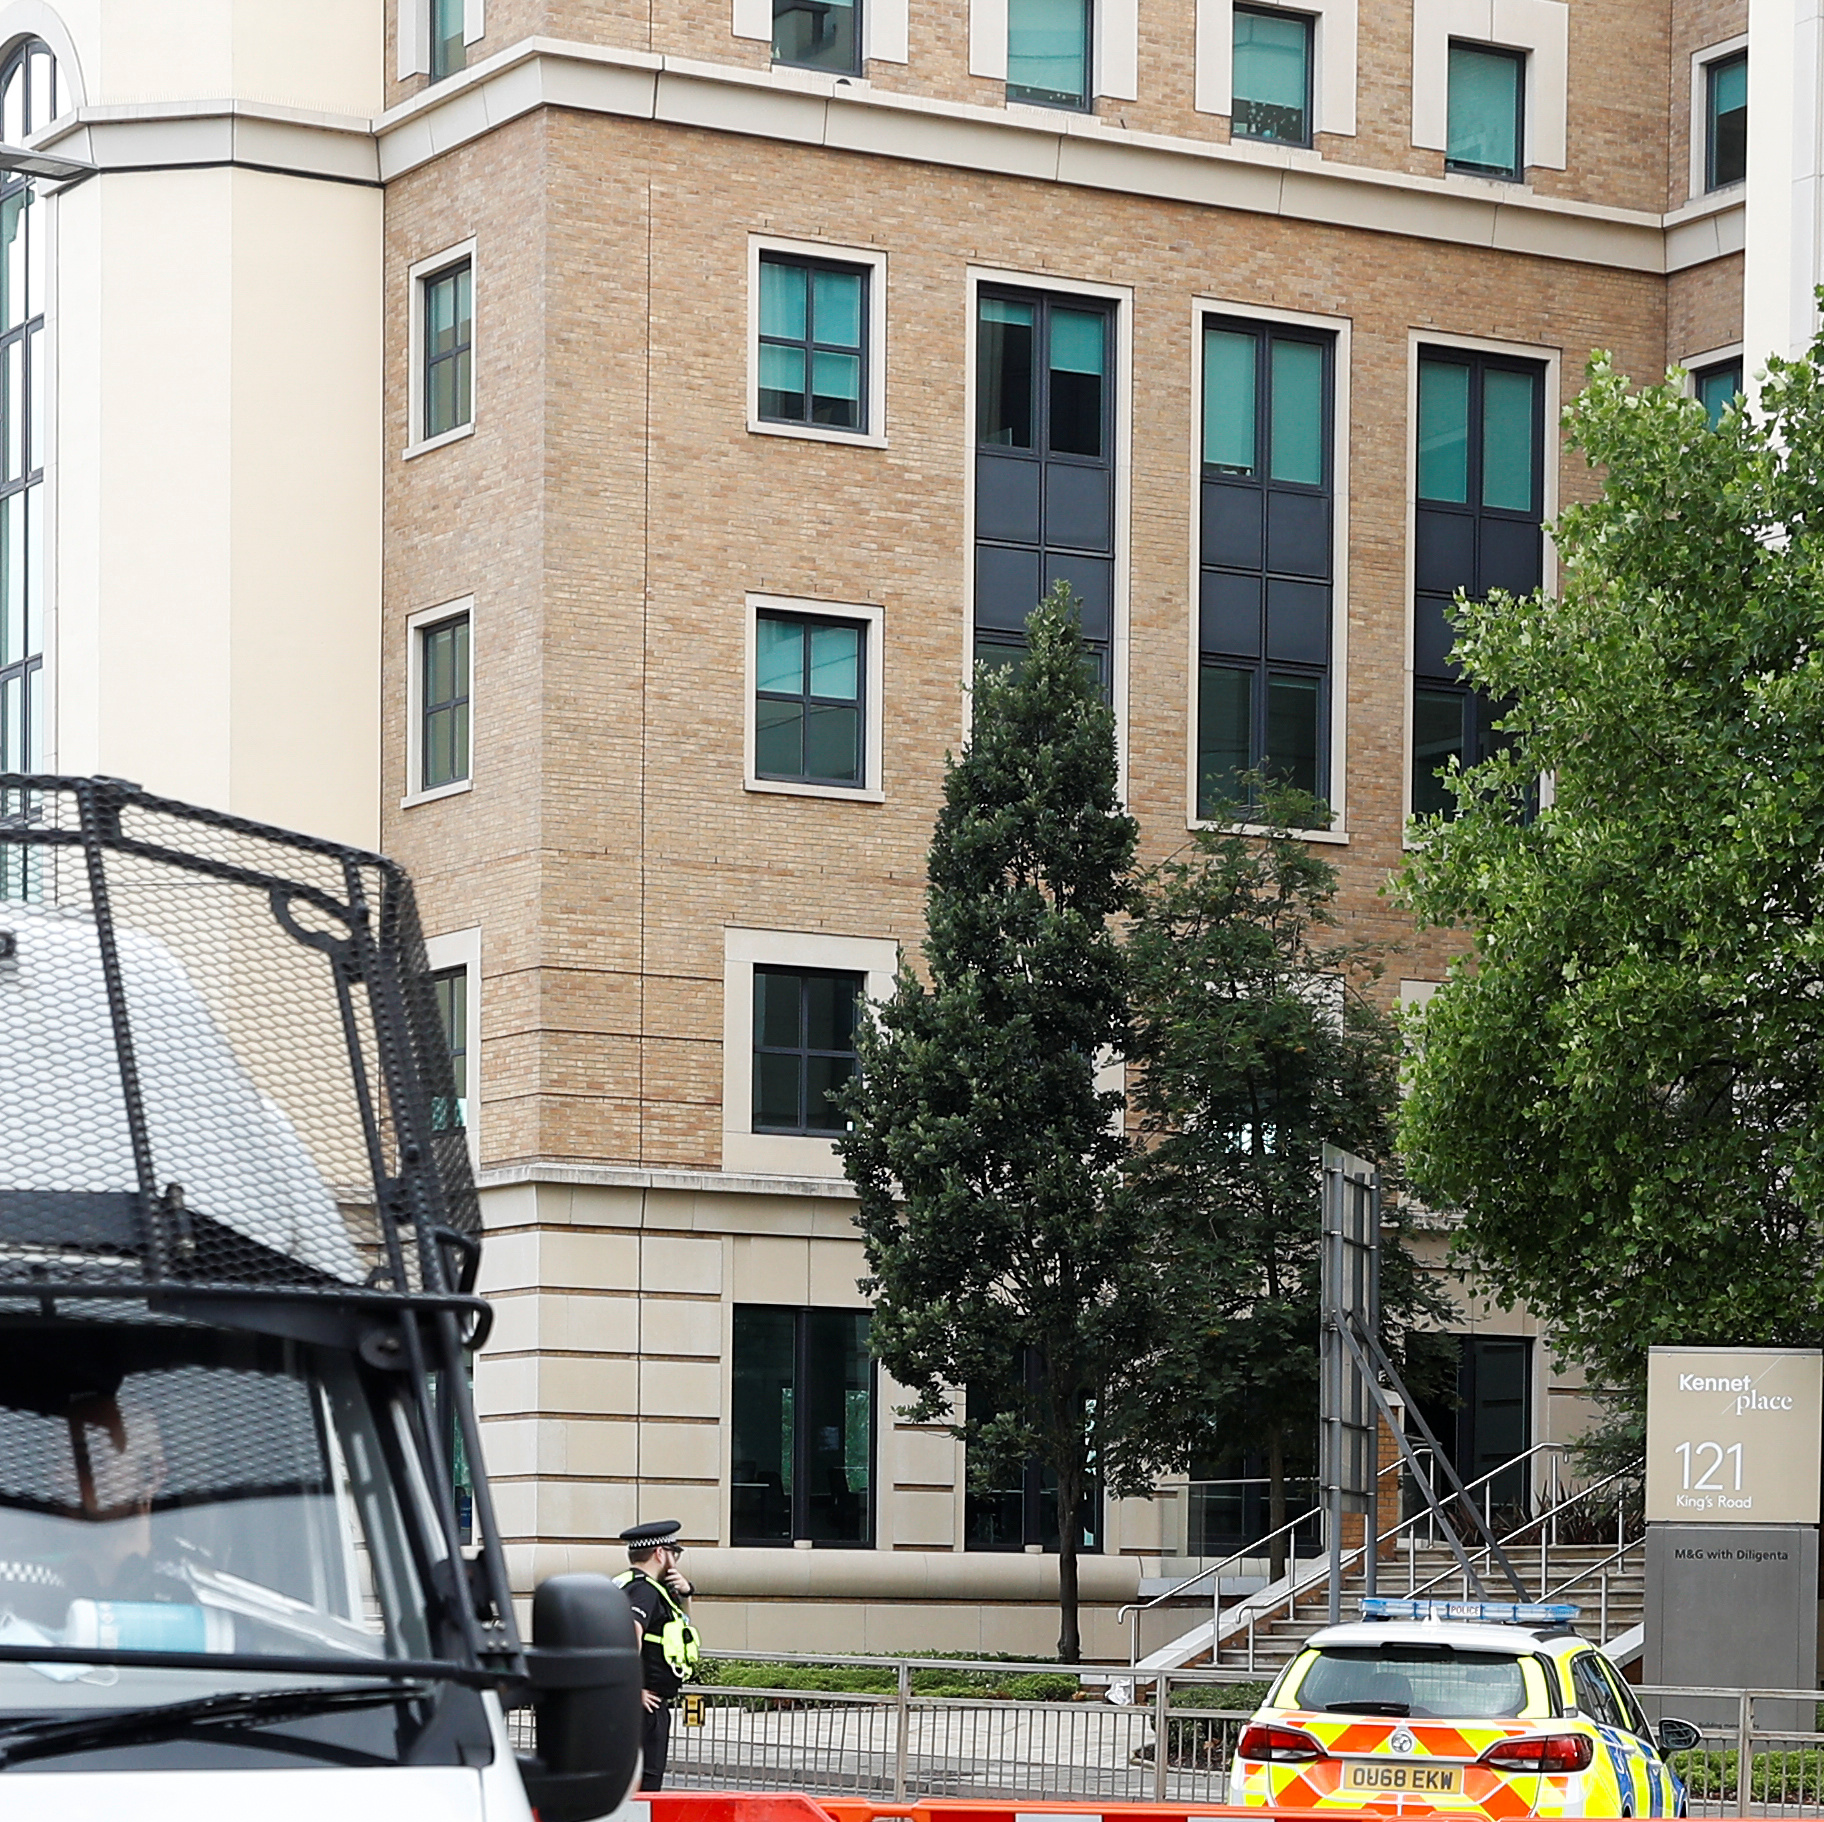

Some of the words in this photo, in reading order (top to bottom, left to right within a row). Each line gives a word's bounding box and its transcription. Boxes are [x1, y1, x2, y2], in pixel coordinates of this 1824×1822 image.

[1679, 1373, 1751, 1392] Kennet
[1736, 1389, 1793, 1416] place
[1674, 1441, 1743, 1492] 121
[1676, 1495, 1713, 1511] King's
[1717, 1495, 1752, 1509] Road
[1674, 1549, 1703, 1560] M&G
[1706, 1548, 1733, 1560] with
[1736, 1548, 1789, 1563] Diligenta
[1451, 1606, 1480, 1615] POLICE
[1353, 1765, 1407, 1789] OU68
[1412, 1768, 1454, 1791] EKW
